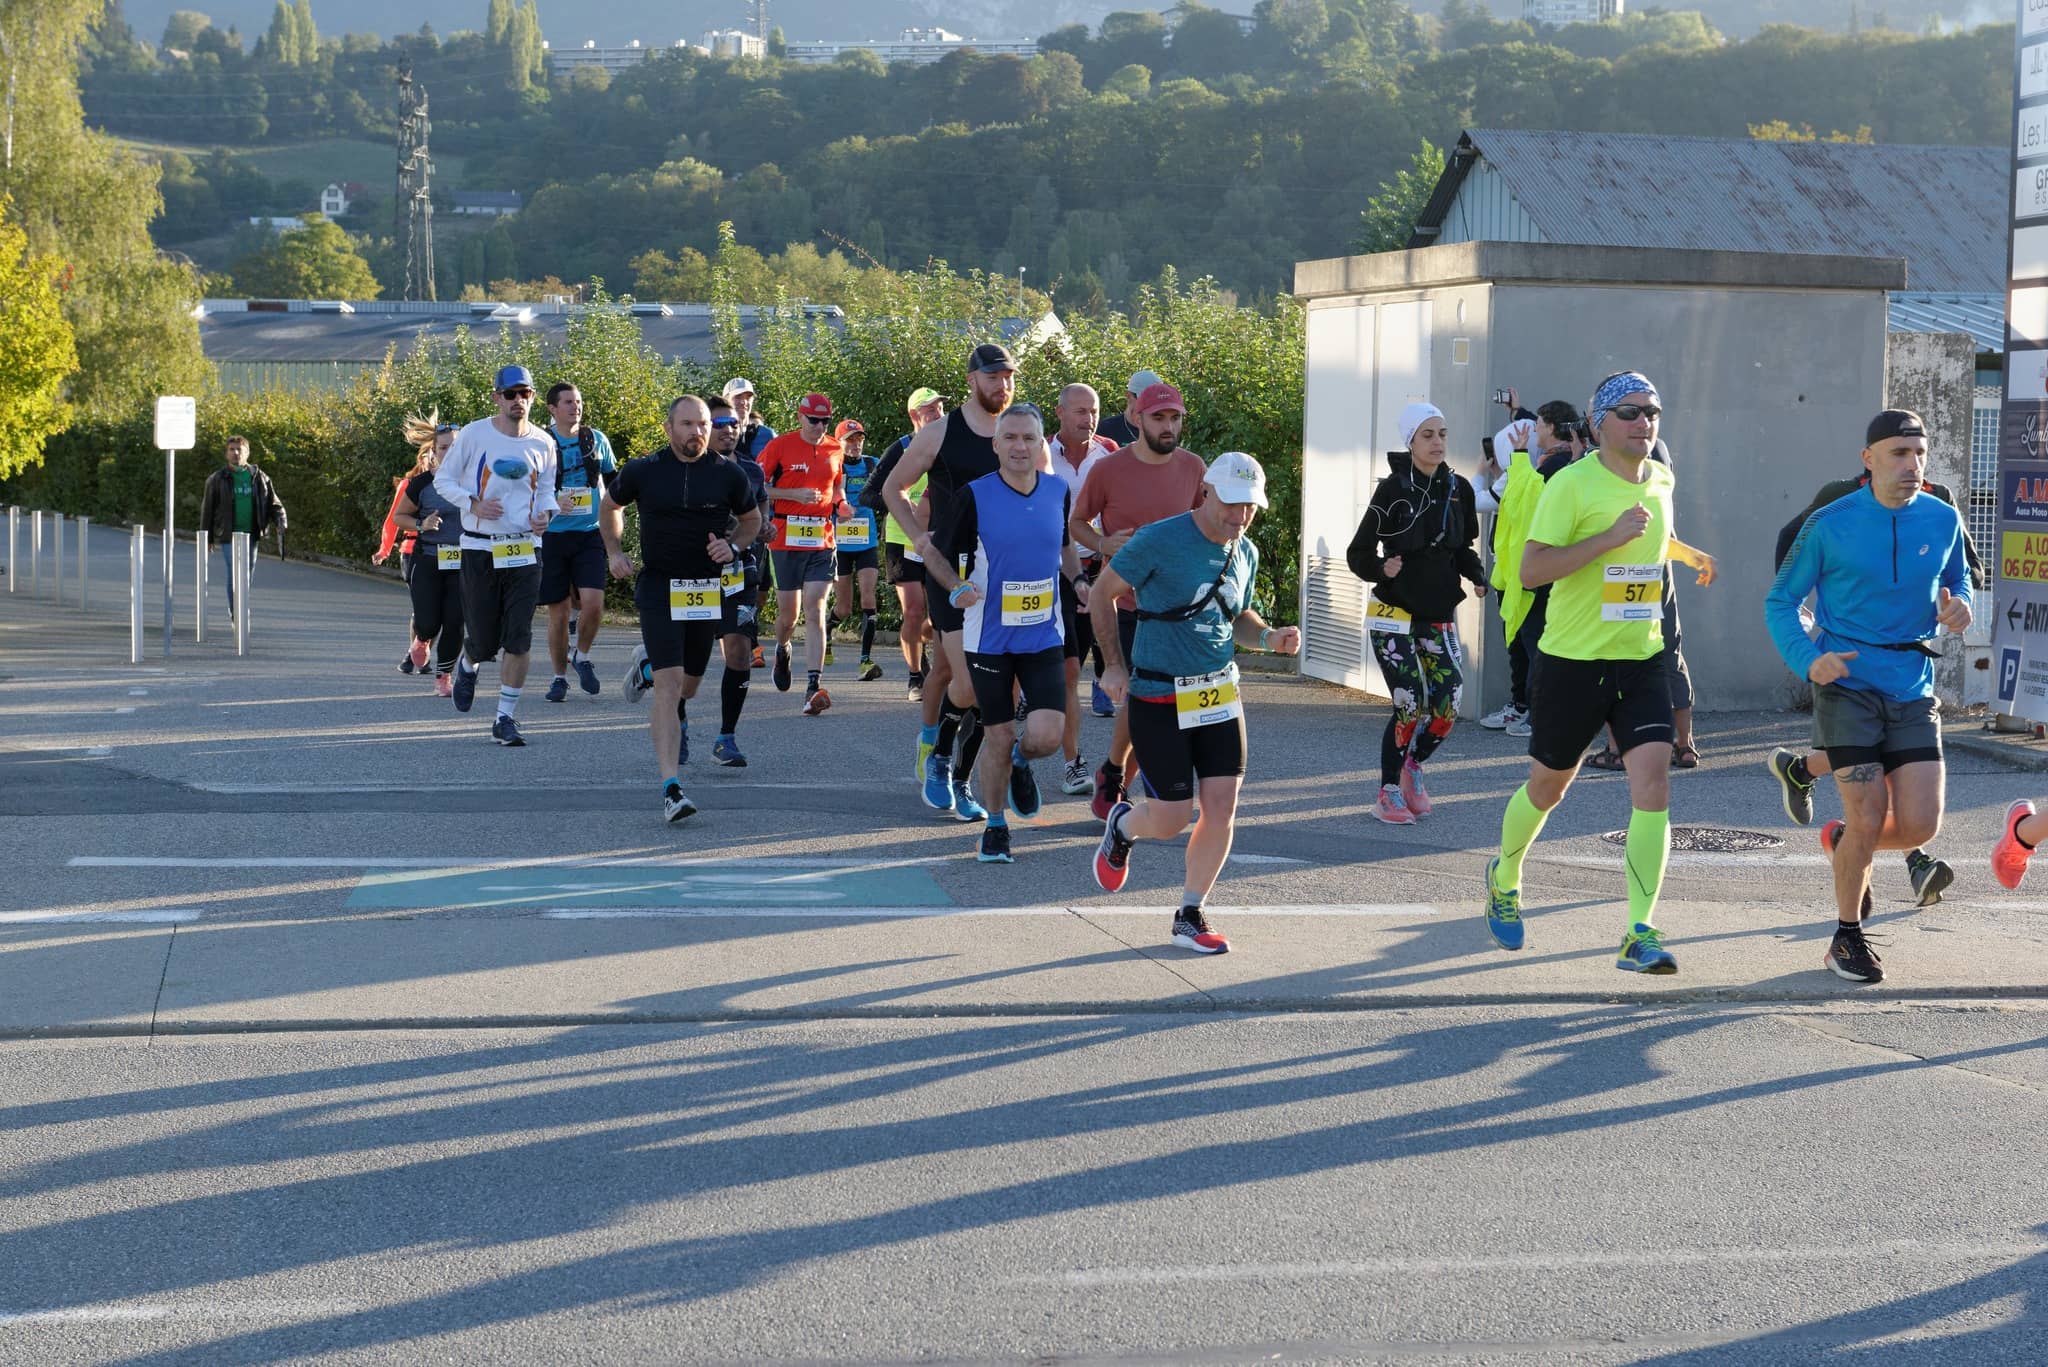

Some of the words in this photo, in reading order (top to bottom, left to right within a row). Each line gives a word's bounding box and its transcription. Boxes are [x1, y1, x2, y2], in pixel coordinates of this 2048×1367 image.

[799, 527, 813, 536] 15
[847, 527, 859, 535] 58
[506, 545, 521, 556] 33
[2025, 535, 2032, 555] A
[2004, 558, 2019, 577] 06
[2023, 559, 2037, 577] 67
[686, 593, 704, 606] 35
[1624, 584, 1647, 602] 57
[1022, 595, 1040, 611] 59
[1376, 603, 1394, 618] 22
[2003, 659, 2016, 692] P
[1199, 689, 1220, 708] 32
